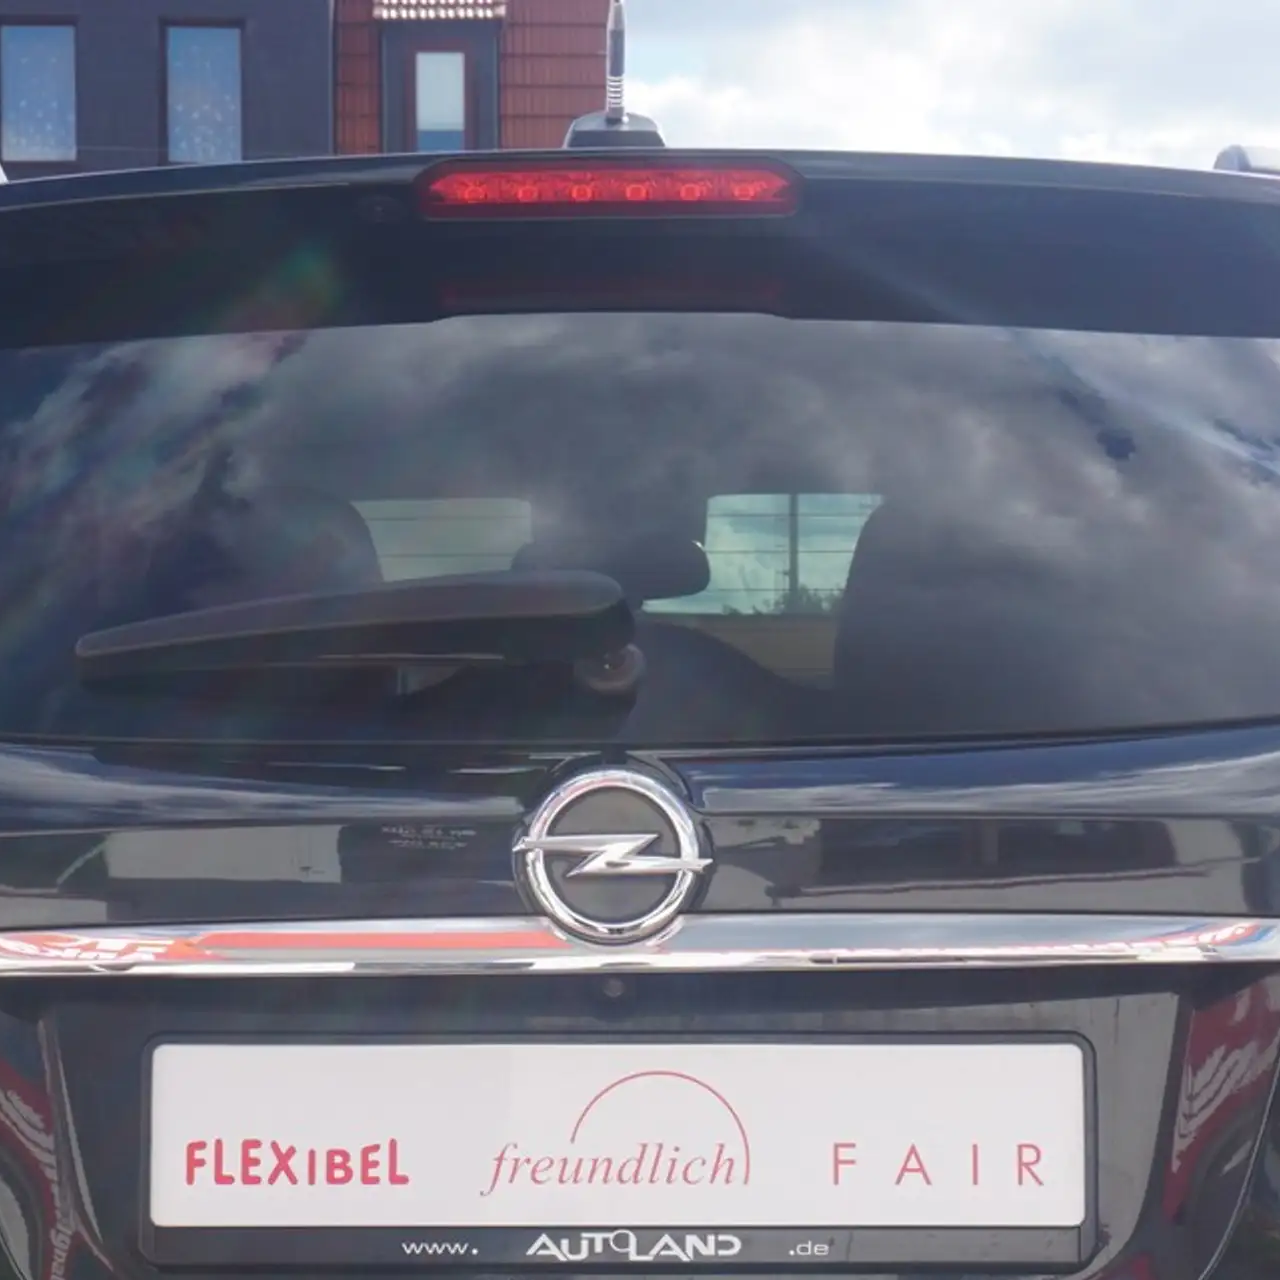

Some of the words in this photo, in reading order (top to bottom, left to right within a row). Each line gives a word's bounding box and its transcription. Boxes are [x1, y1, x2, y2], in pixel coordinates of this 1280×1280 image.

[185, 1138, 410, 1186] FLEXIBEL
[478, 1142, 736, 1197] freundlich
[832, 1143, 1045, 1186] FAIR
[525, 1229, 742, 1262] AUTOLAND
